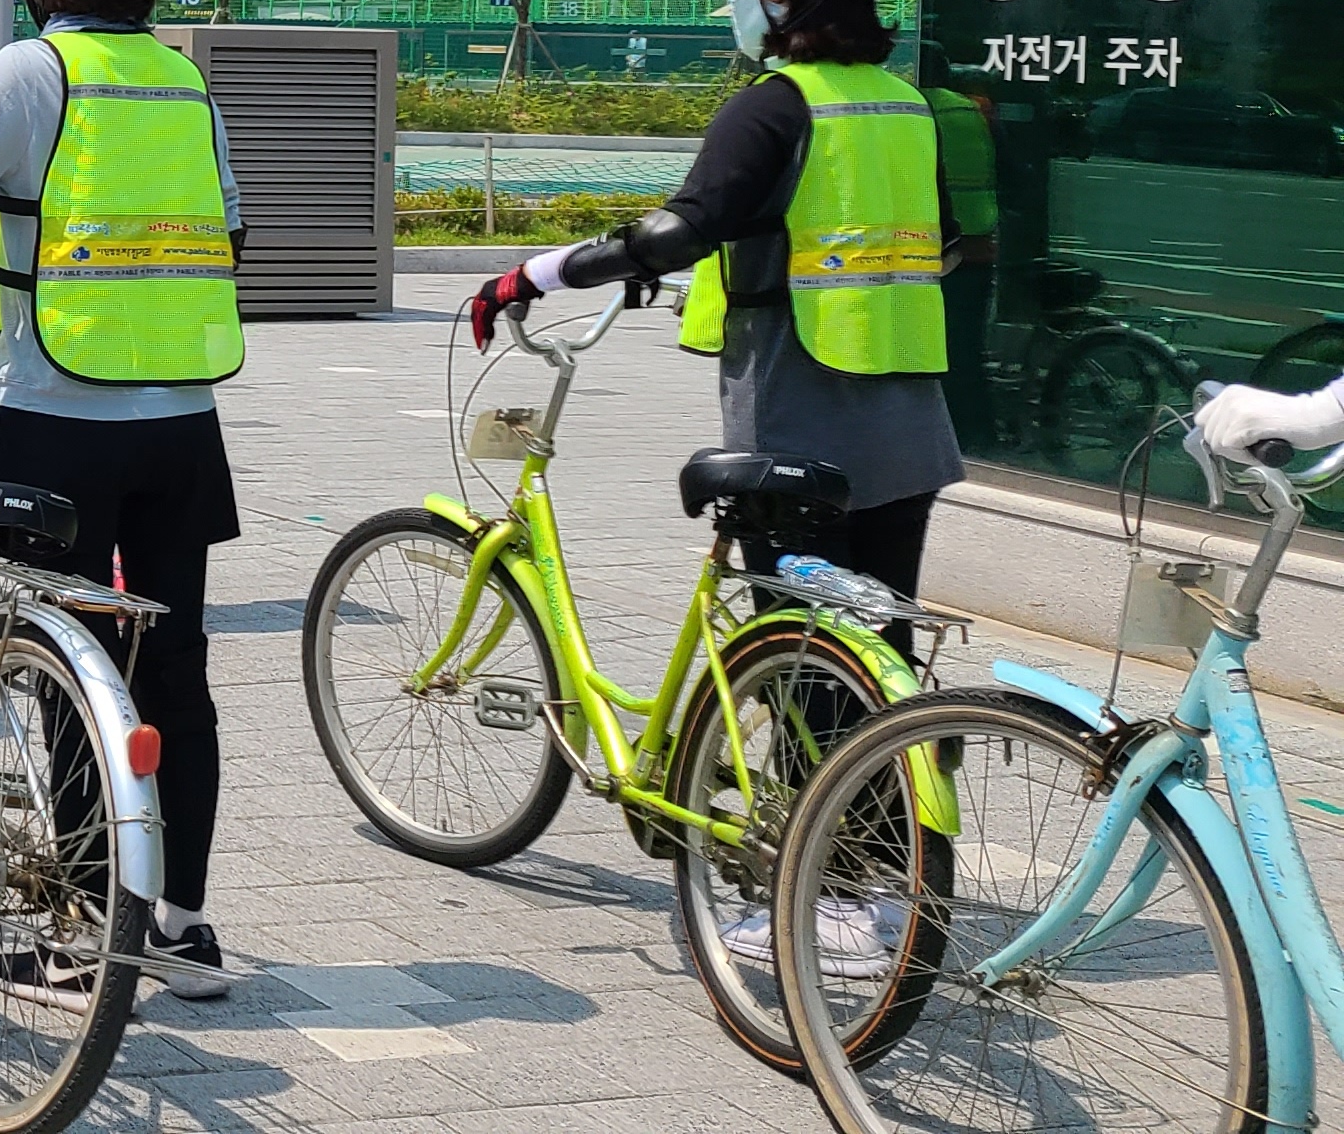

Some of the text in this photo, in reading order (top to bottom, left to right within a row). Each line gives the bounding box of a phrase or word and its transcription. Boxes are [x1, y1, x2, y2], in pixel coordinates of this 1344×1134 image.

[981, 33, 1183, 88] 자전거 주차
[772, 465, 806, 478] PHLOX
[3, 497, 35, 512] PHLOX
